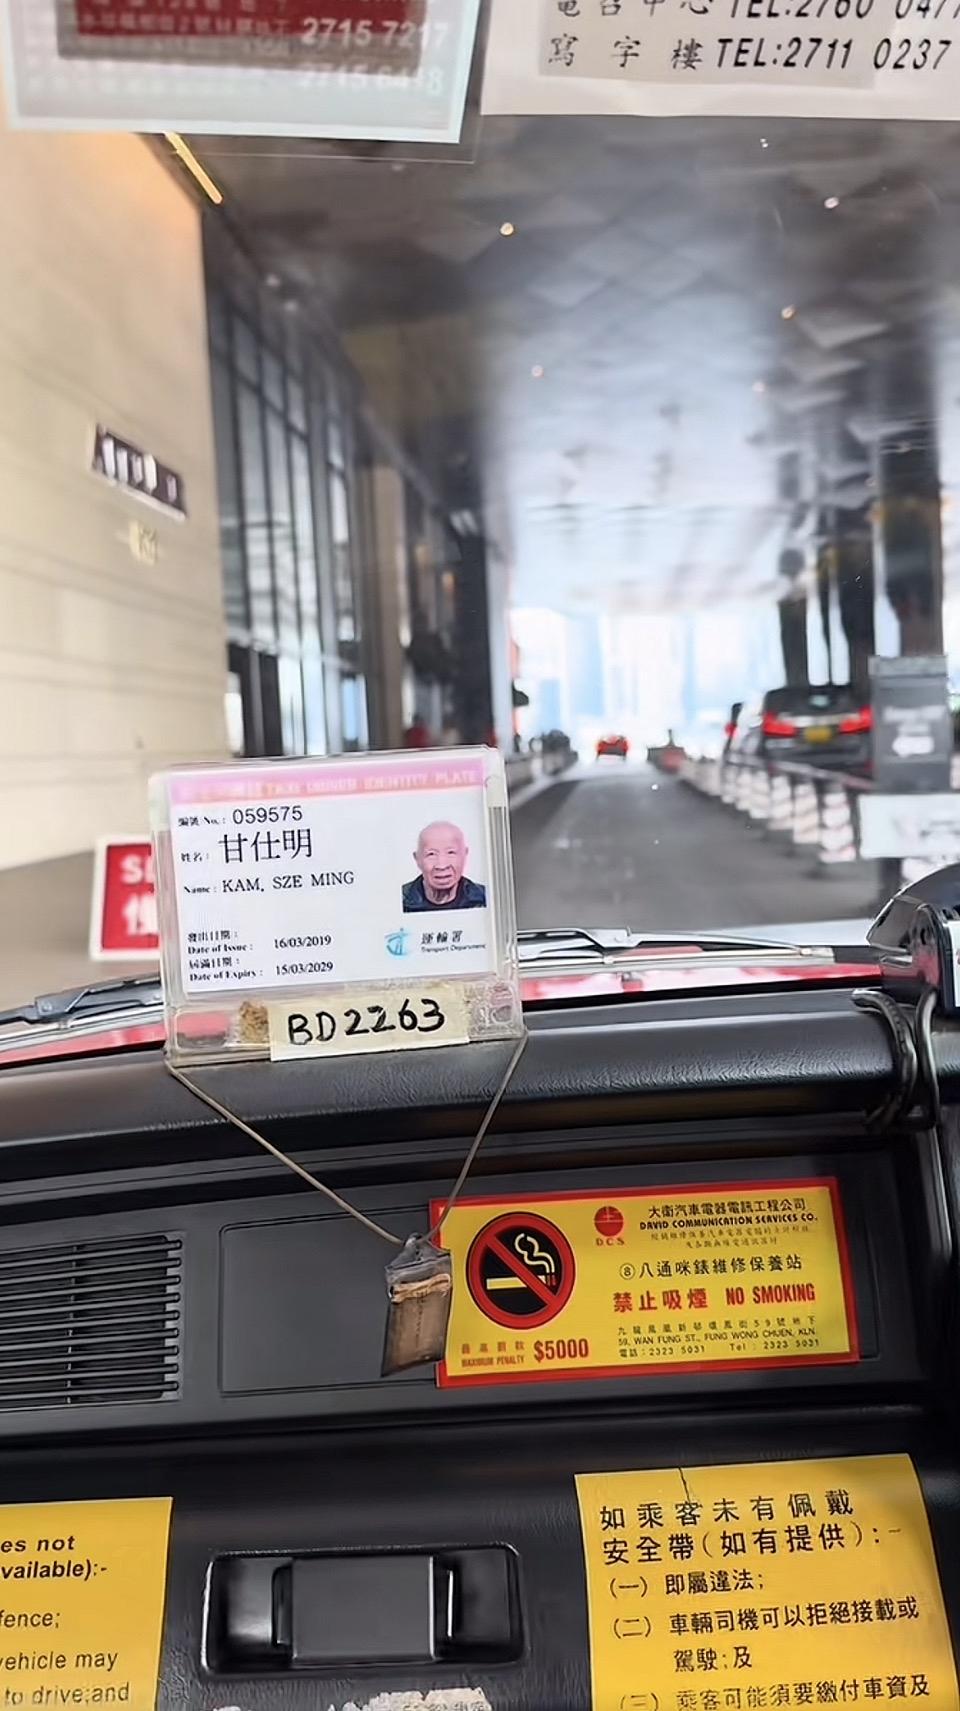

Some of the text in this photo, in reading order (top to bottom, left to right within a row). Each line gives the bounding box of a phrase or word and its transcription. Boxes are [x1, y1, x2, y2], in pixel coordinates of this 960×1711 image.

[548, 33, 952, 70] 寫字樓 TEL:2711 0237
[435, 770, 477, 784] PLATE
[233, 805, 303, 824] 059575
[218, 828, 313, 863] 甘仕明
[272, 875, 303, 890] SZE
[311, 871, 355, 887] MING
[188, 944, 209, 954] Date
[212, 944, 221, 953] of
[274, 934, 332, 949] 16/03/2019
[190, 971, 211, 981] Date
[214, 971, 223, 979] of
[276, 961, 334, 976] 15/03/2029
[640, 1220, 669, 1230] DAVID
[672, 1215, 752, 1229] COMMUNICATION
[755, 1213, 798, 1225] SERVICES
[613, 1283, 816, 1313] 禁止吸煙 NO SMOKING
[634, 1336, 654, 1345] WAN
[657, 1335, 682, 1344] FUNG
[704, 1332, 728, 1341] FUNG
[731, 1330, 759, 1340] WONG
[681, 1345, 705, 1354] 5031
[764, 1341, 789, 1350] 2323
[796, 1339, 820, 1348] 5031
[497, 1355, 525, 1365] PENALTY
[534, 1338, 589, 1363] $5000
[600, 1489, 854, 1531] 如乘客未有佩戴
[37, 1535, 75, 1552] not
[669, 1596, 920, 1637] 車輛司機可以拒絕接載或
[75, 1652, 118, 1672] may
[6, 1687, 24, 1706] to
